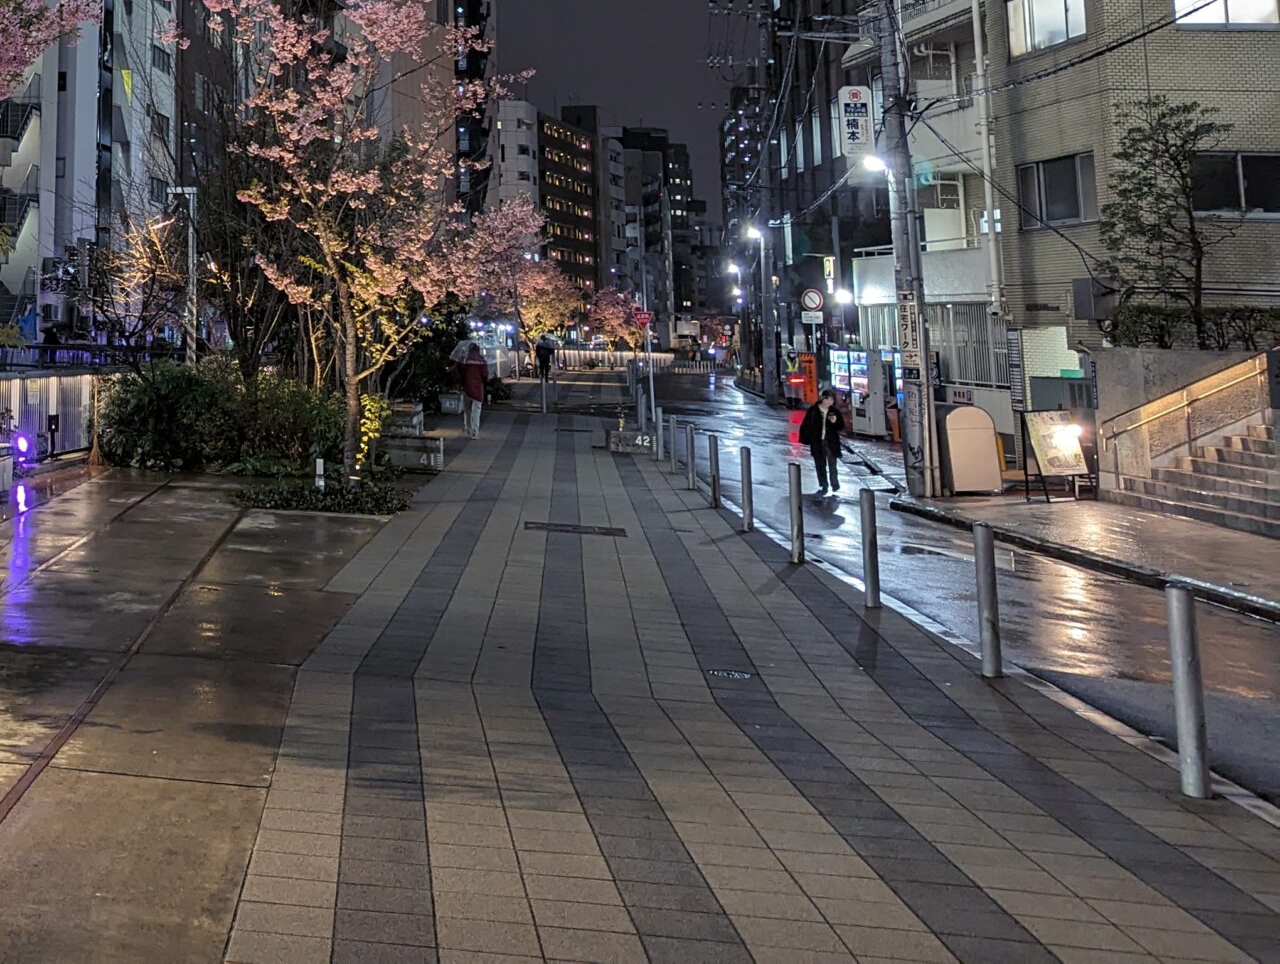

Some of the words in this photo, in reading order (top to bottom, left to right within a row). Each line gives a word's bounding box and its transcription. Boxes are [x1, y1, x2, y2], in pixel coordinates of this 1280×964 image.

[900, 304, 910, 349] 在宅ワーク
[635, 435, 650, 446] 42
[420, 453, 435, 466] 41
